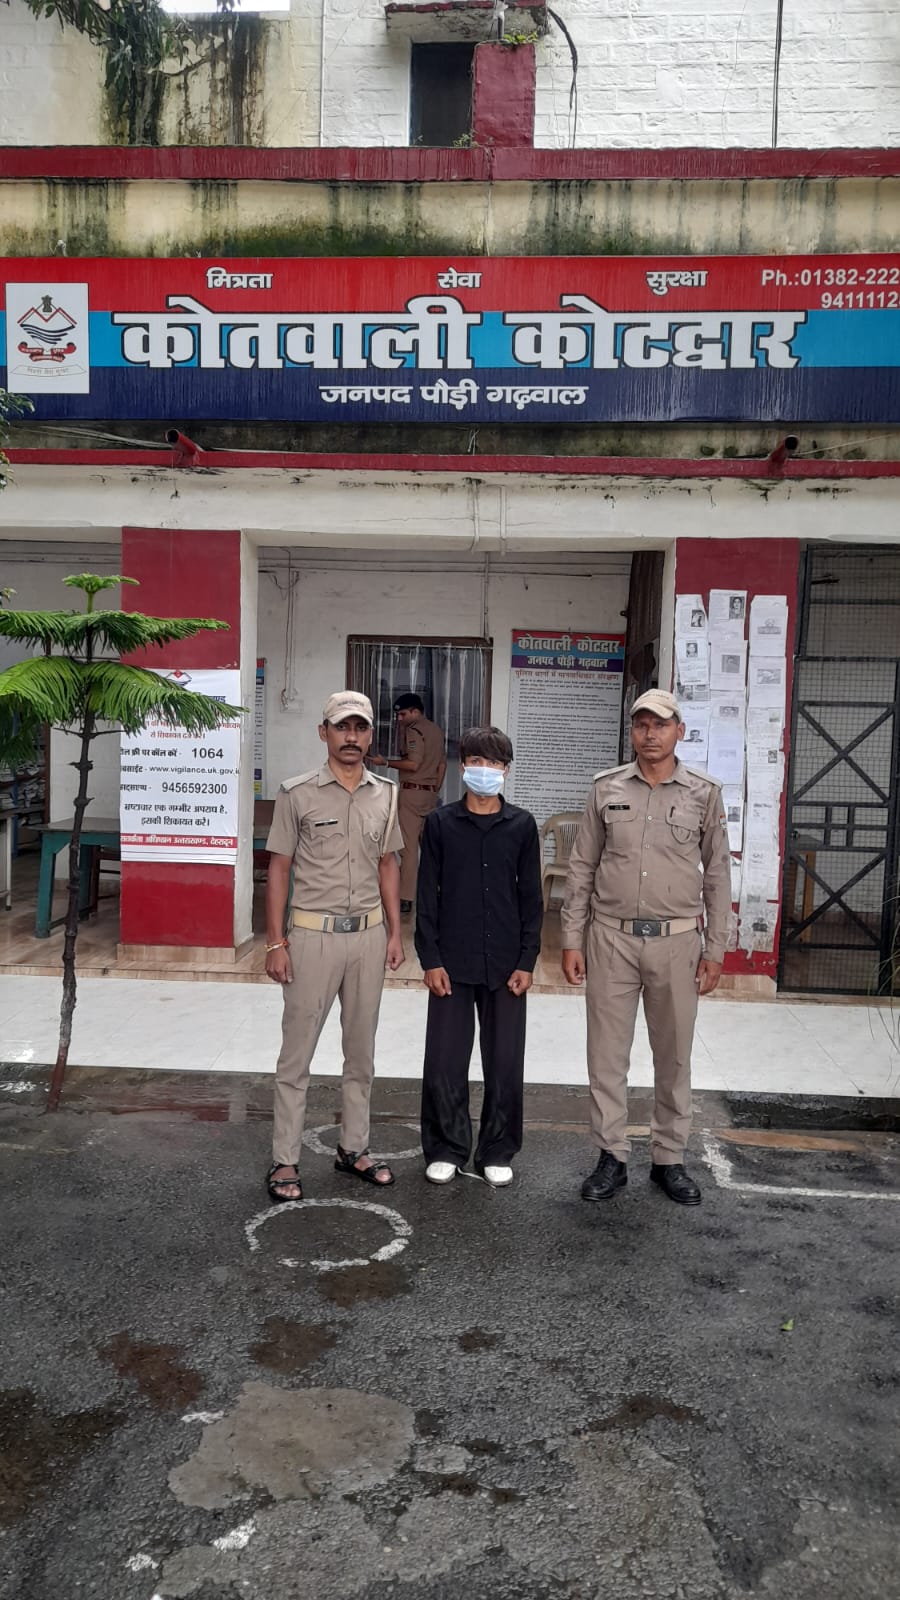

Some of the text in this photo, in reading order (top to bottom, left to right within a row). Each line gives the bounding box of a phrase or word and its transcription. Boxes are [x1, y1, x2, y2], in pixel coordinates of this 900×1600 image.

[206, 266, 273, 290] मित्रता
[437, 267, 482, 289] सेवा
[646, 270, 708, 296] सुरक्षा
[761, 267, 900, 287] Ph.:01382-222
[821, 291, 900, 309] 9411112
[111, 293, 808, 370] कोतवाली कोटद्वार
[319, 378, 589, 411] जनपद पौड़ी गढ़वाल
[517, 634, 620, 654] कोतवाली कोटद्वार
[527, 655, 554, 666] जनपद
[191, 747, 224, 759] 1064
[162, 781, 228, 794] 9456592300
[163, 816, 193, 827] शिकायत
